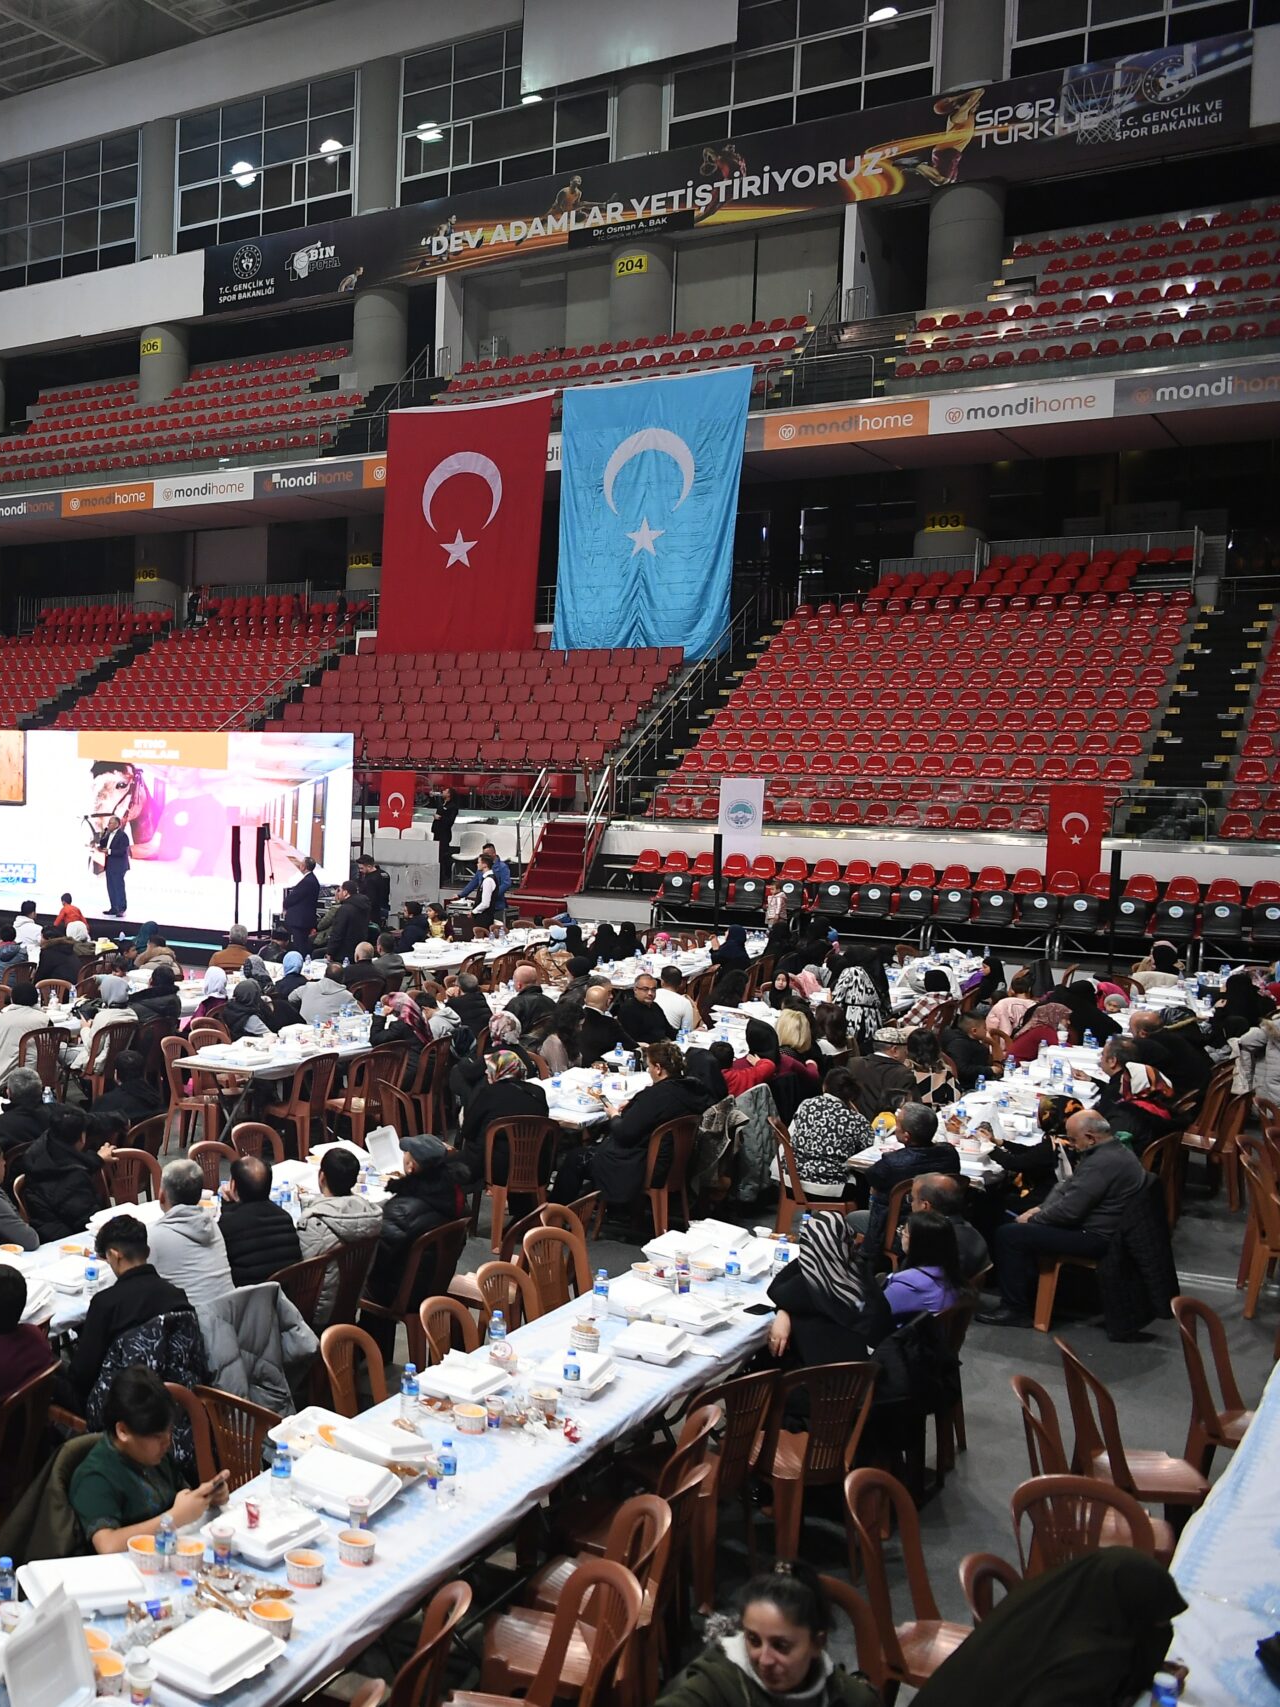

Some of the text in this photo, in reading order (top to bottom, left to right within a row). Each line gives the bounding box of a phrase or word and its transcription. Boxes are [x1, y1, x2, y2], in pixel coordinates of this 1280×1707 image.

[975, 98, 1056, 129] SPOR
[1116, 100, 1223, 128] T.C. GENÇLİK VE
[1115, 112, 1223, 141] SPOR BAKANLIĞI
[490, 202, 624, 245] ADAMLAR
[607, 224, 636, 234] Osman
[649, 217, 668, 226] BAK
[617, 258, 644, 273] 204
[233, 279, 264, 292] GENÇLİK
[219, 286, 275, 304] SPOR BAKANLIĞI
[141, 342, 158, 353] 206
[1156, 375, 1280, 401] mondihom
[966, 391, 1096, 421] mondihome
[799, 413, 914, 436] mondihome
[81, 490, 146, 507] mondihome
[174, 480, 244, 499] mondihome
[929, 515, 961, 528] 103
[350, 555, 369, 565] 105
[137, 569, 155, 580] 106
